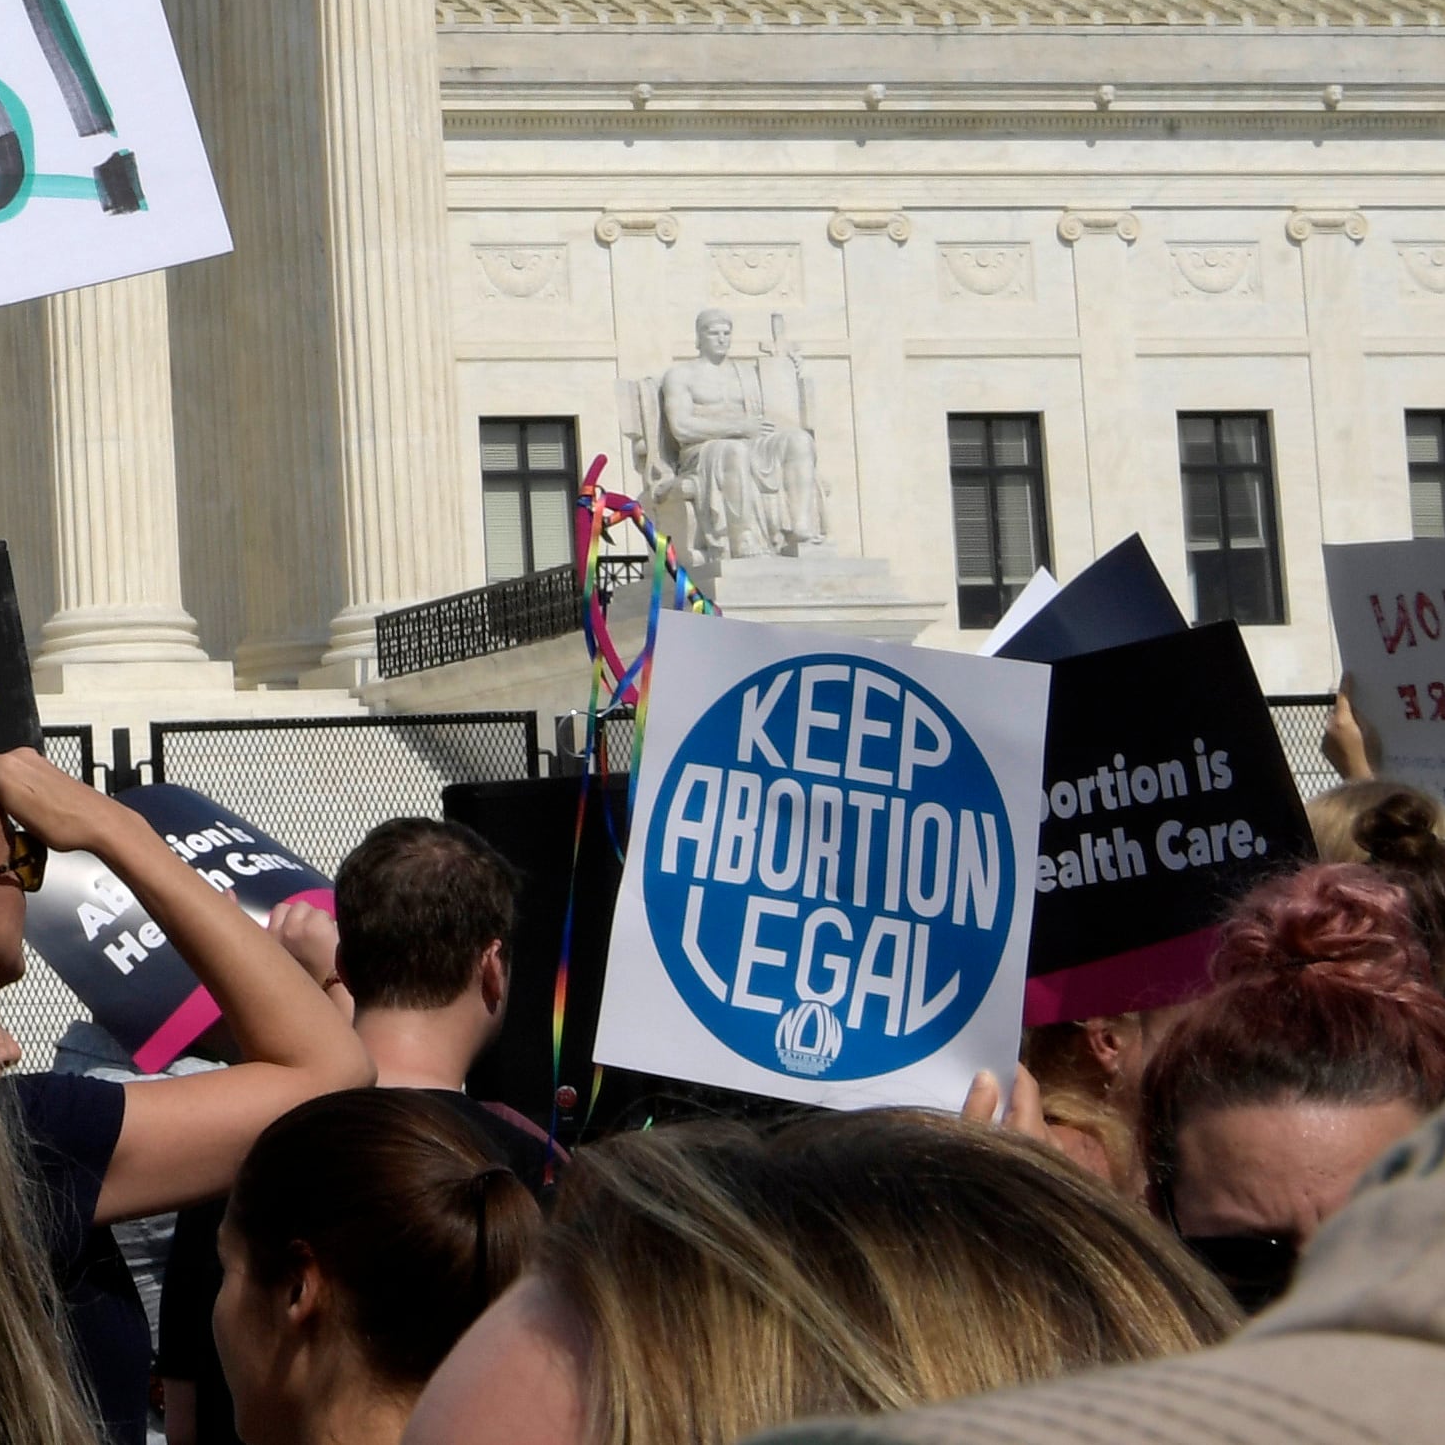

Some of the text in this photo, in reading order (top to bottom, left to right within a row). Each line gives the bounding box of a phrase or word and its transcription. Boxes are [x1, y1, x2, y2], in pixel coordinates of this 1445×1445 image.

[737, 663, 952, 791] KEEP
[1040, 737, 1233, 824] ortion is
[225, 851, 304, 876] Care.
[661, 762, 1001, 931] ABORTION
[1035, 819, 1267, 893] ealth Care.
[681, 885, 961, 1037] LEGAL
